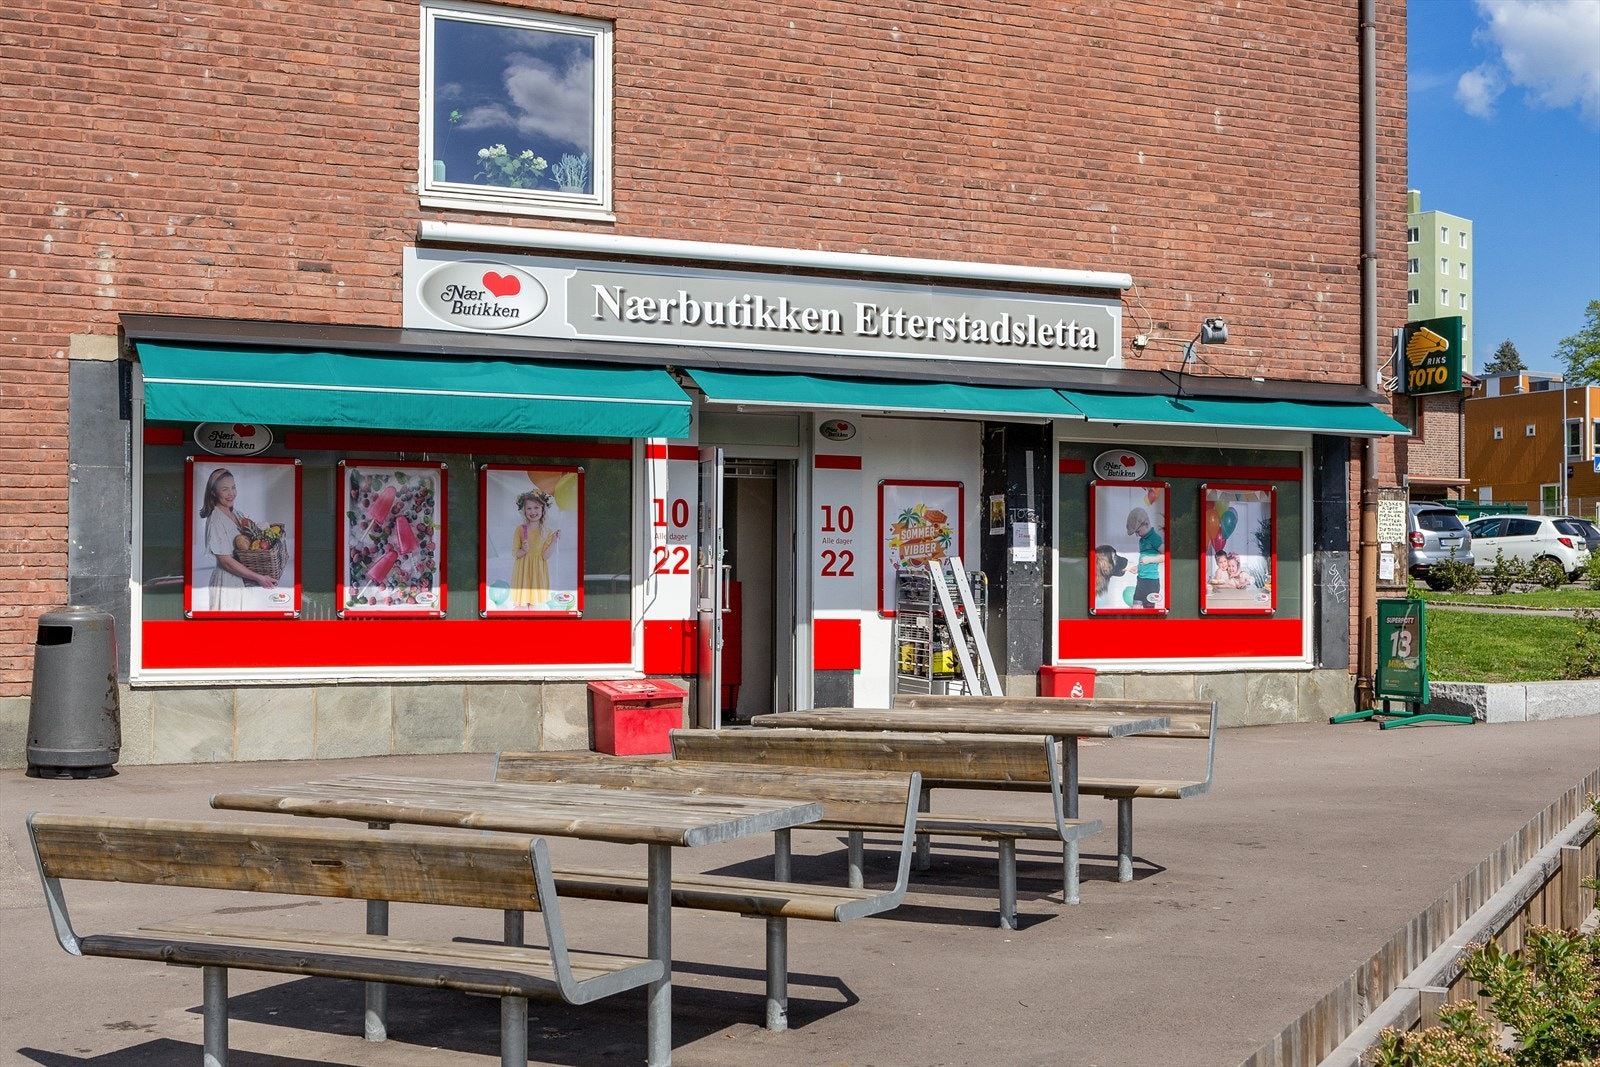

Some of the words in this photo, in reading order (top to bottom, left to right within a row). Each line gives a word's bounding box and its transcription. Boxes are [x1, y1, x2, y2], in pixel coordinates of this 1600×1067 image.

[440, 284, 486, 302] Nær
[450, 300, 520, 318] Butikken
[591, 284, 843, 333] Nærbutikken
[853, 301, 1098, 350] Etterstadsletta
[1427, 356, 1447, 365] RIKS
[1408, 366, 1448, 387] TOTO
[208, 430, 235, 442] Nær
[214, 439, 256, 450] Butikken
[653, 498, 690, 528] 10
[821, 505, 854, 533] 10
[669, 533, 688, 541] dager
[822, 537, 835, 545] Alle
[835, 537, 853, 546] dager
[904, 543, 937, 556] VIBBER
[653, 546, 689, 574] 22
[821, 549, 854, 576] 22
[1390, 630, 1412, 658] 13
